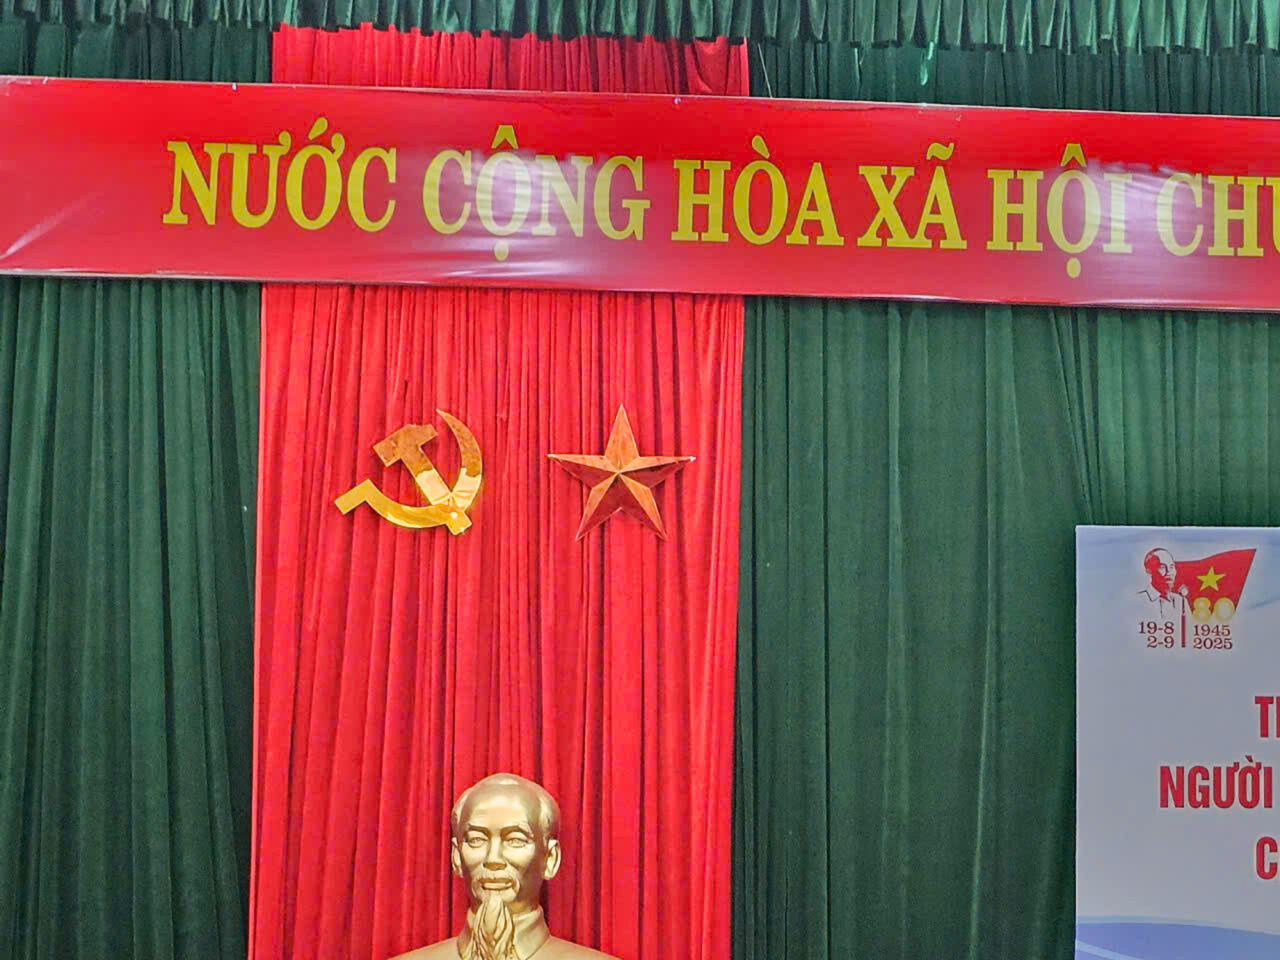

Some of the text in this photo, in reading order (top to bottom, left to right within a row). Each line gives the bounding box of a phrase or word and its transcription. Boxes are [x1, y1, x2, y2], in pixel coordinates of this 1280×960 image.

[163, 116, 397, 233] NƯỚC
[422, 124, 651, 262] CỘNG
[672, 134, 845, 247] HÒA
[857, 142, 967, 252] XÃ
[986, 143, 1134, 279] HỘI
[1139, 621, 1174, 634] 19-8
[1193, 624, 1231, 636] 1945
[1147, 636, 1174, 648] 2-9
[1193, 638, 1233, 649] 2025
[1159, 755, 1274, 810] NGƯỜI
